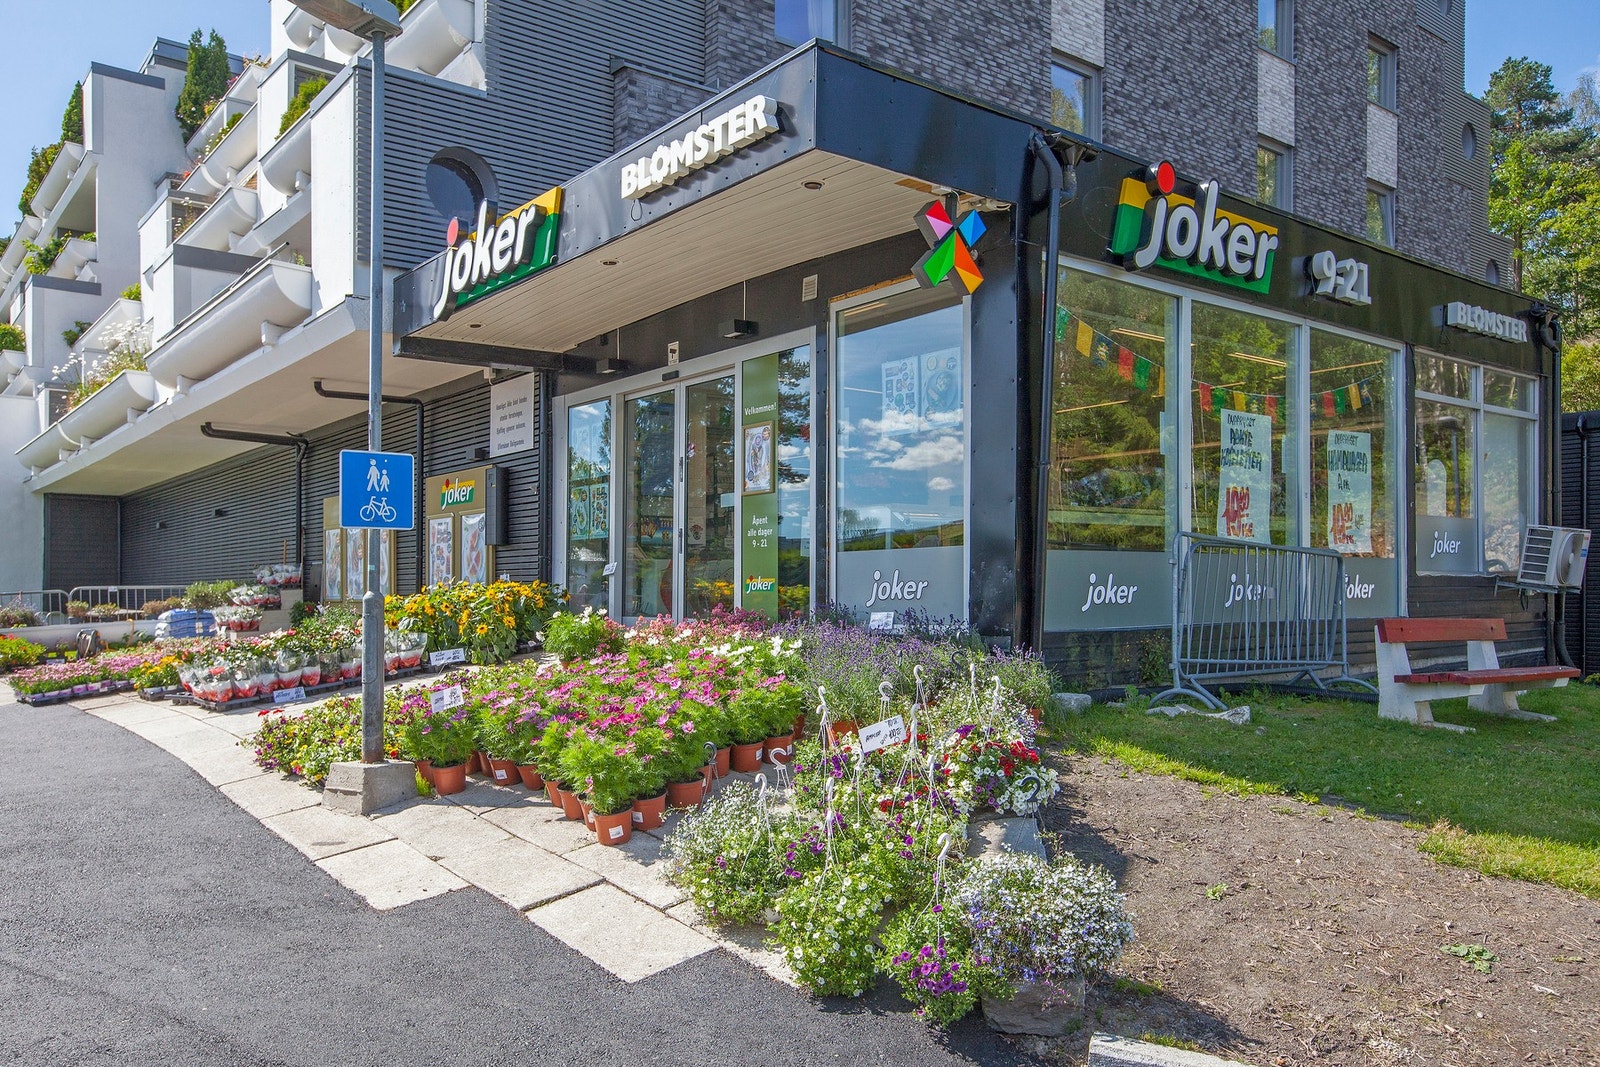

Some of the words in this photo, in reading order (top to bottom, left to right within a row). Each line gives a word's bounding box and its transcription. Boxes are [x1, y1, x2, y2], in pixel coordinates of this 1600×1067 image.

[1134, 160, 1279, 280] joker
[433, 198, 538, 321] joker
[1312, 250, 1371, 305] 9-21
[744, 402, 777, 416] Velkommen!
[441, 478, 475, 510] joker
[747, 528, 757, 537] alle
[757, 527, 773, 538] dager
[752, 515, 768, 526] Åpent
[1430, 531, 1461, 559] joker
[746, 574, 774, 595] joker
[865, 569, 928, 607] joker
[1081, 573, 1138, 612] joker
